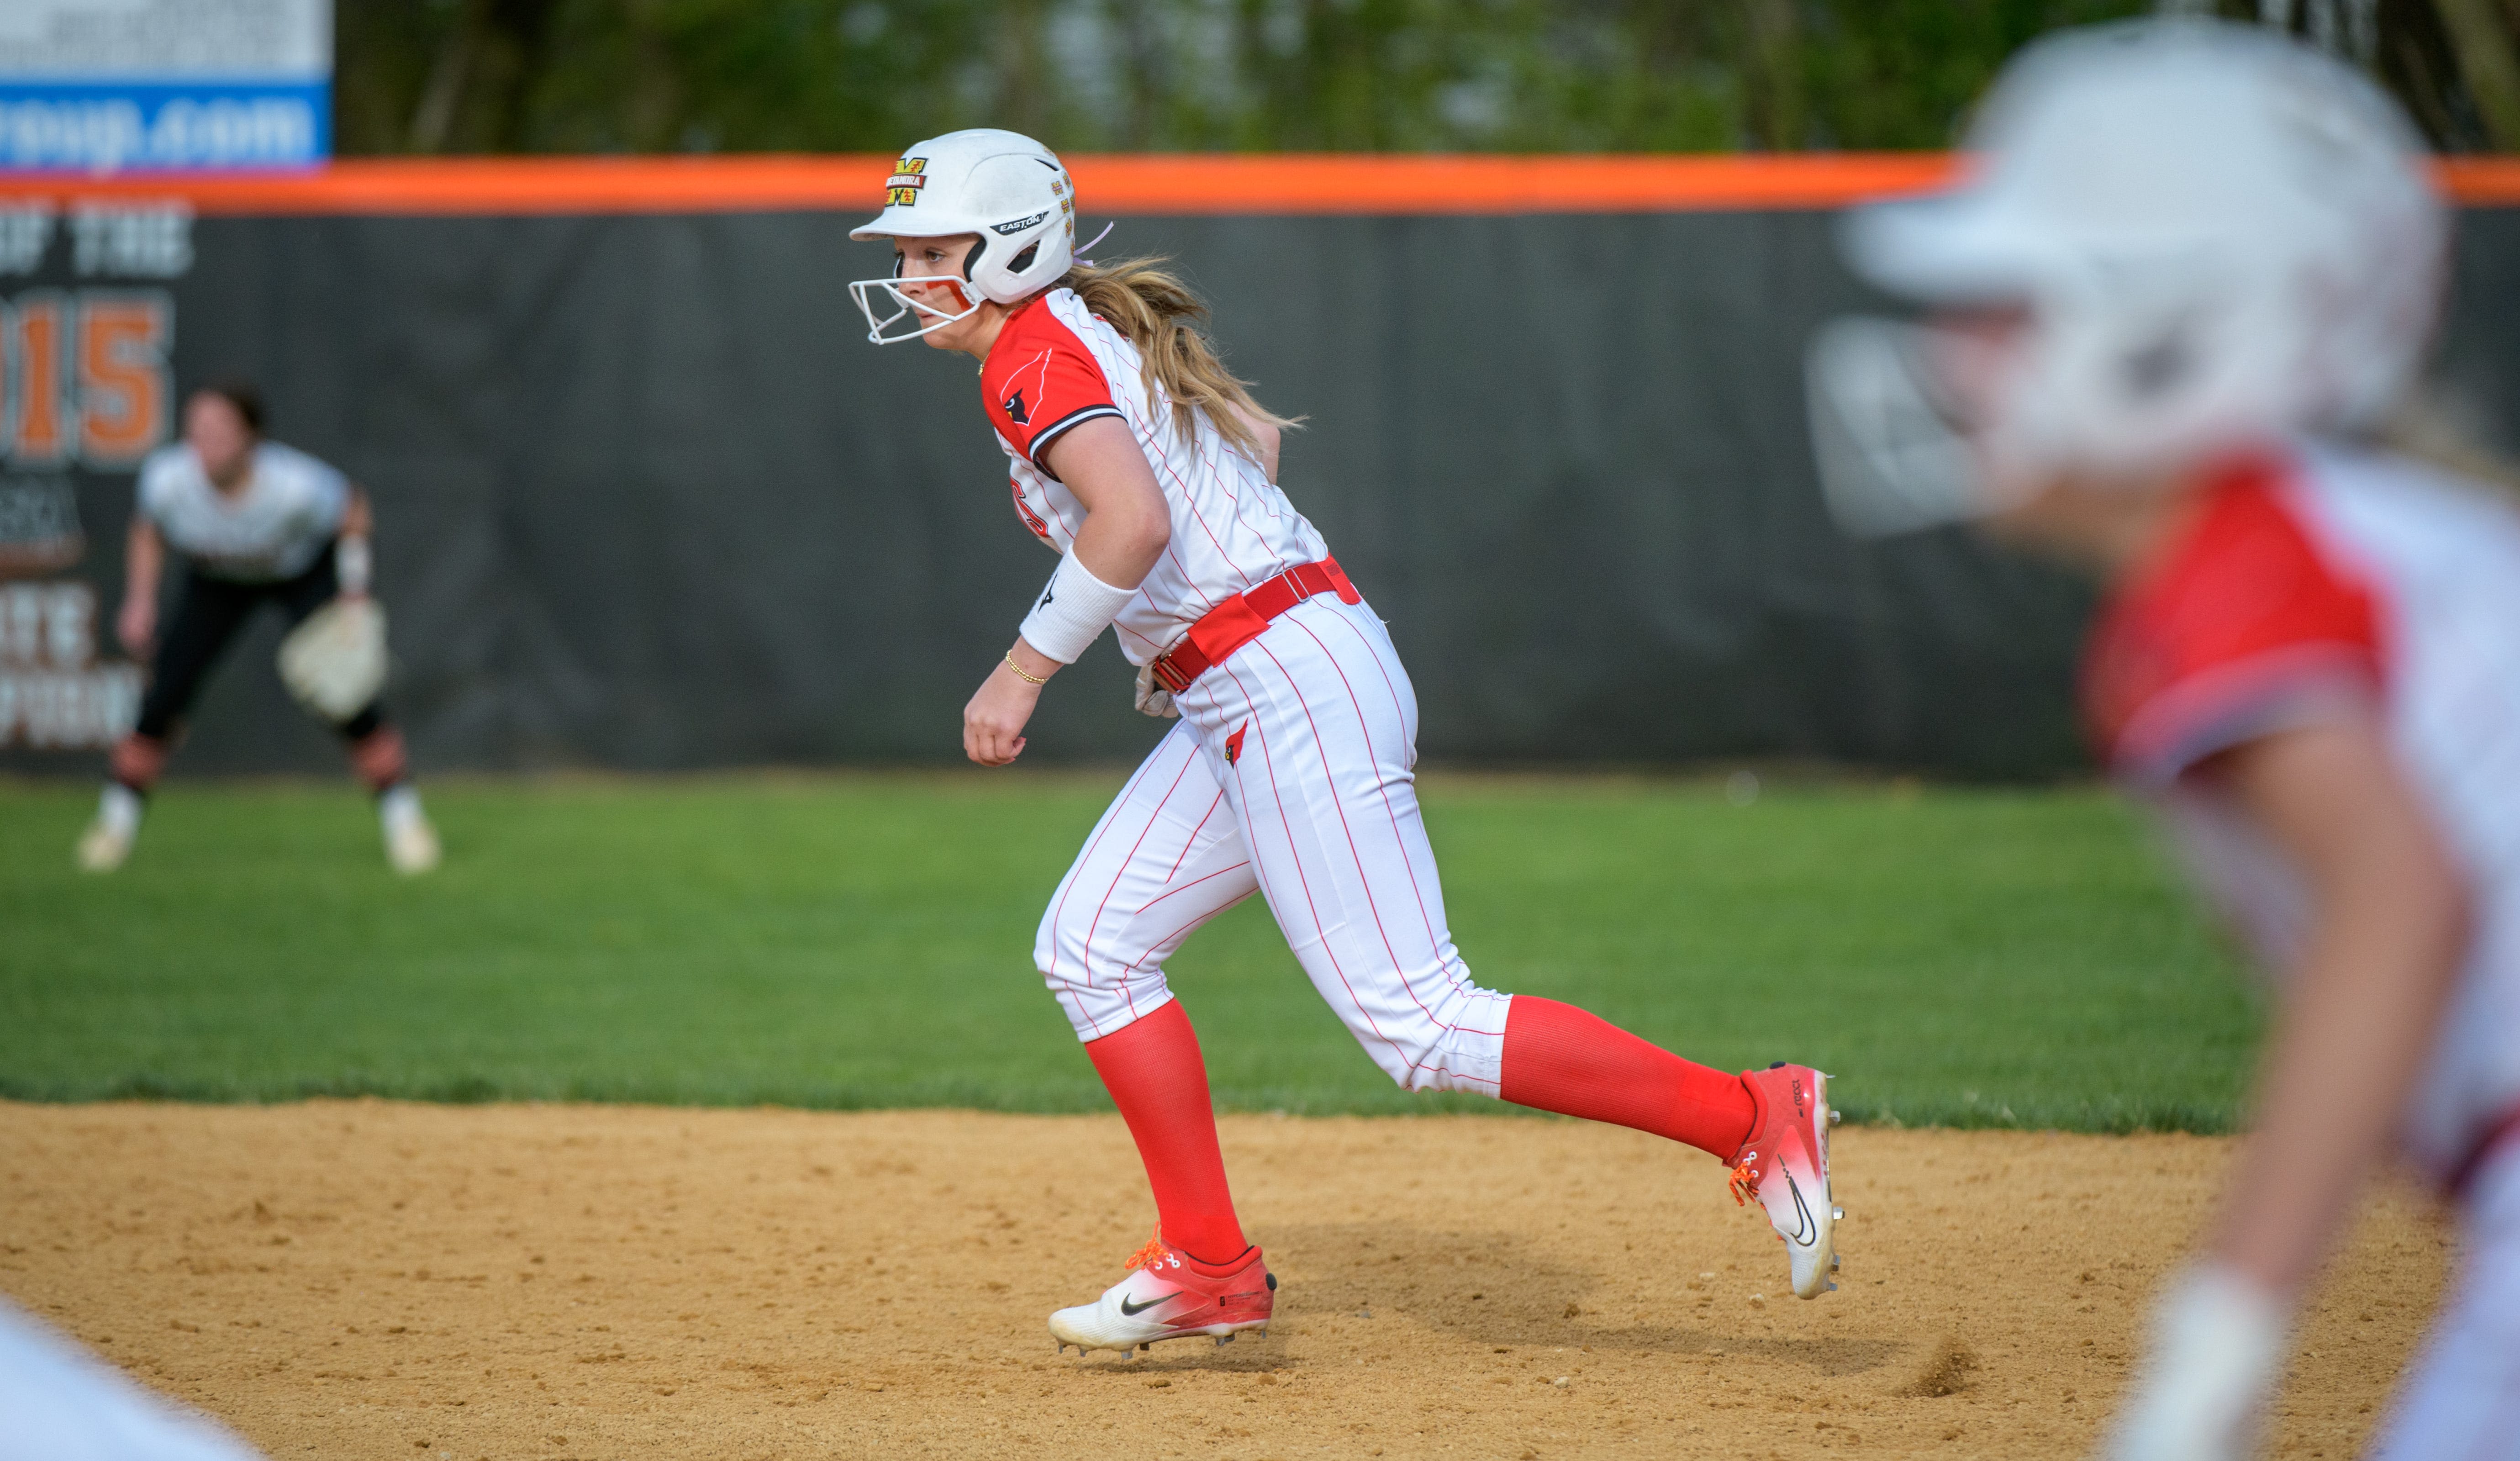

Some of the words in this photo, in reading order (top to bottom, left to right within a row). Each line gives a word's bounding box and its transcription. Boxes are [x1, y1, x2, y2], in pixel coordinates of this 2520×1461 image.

[70, 196, 195, 276] THE
[1000, 216, 1040, 232] EASTON
[1792, 1079, 1802, 1106] react
